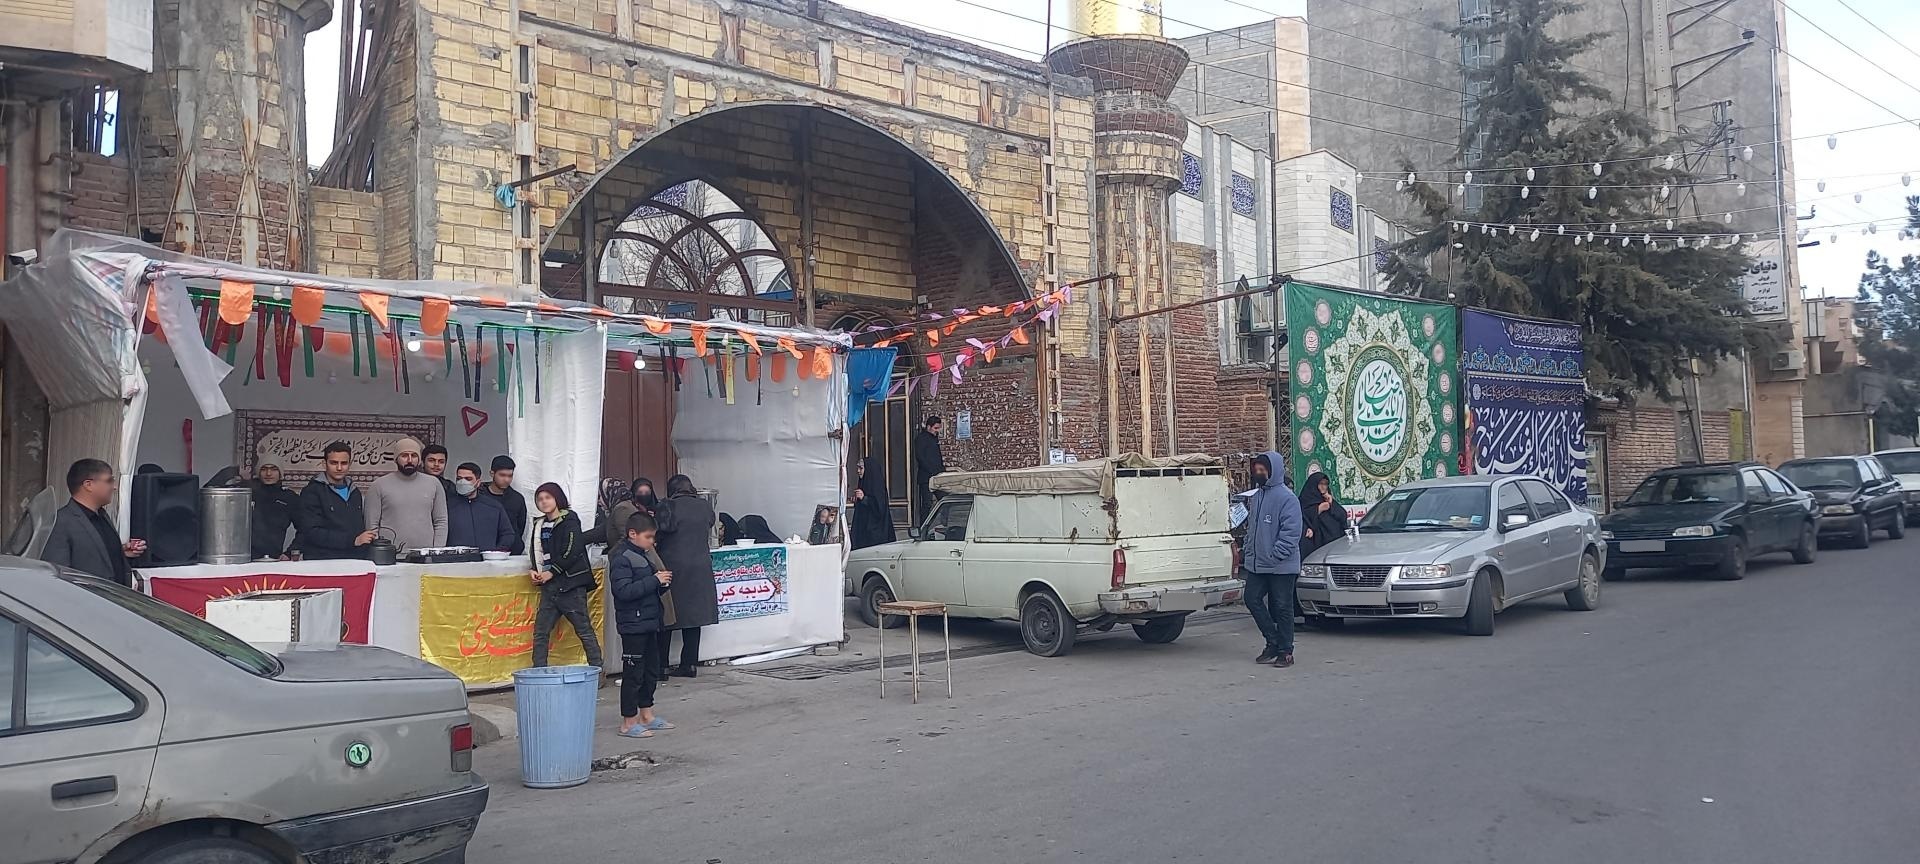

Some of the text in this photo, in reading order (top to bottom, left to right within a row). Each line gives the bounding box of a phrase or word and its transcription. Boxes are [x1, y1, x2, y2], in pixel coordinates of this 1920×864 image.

[1751, 260, 1778, 274] دنیای
[718, 580, 771, 602] خدیجه کبر
